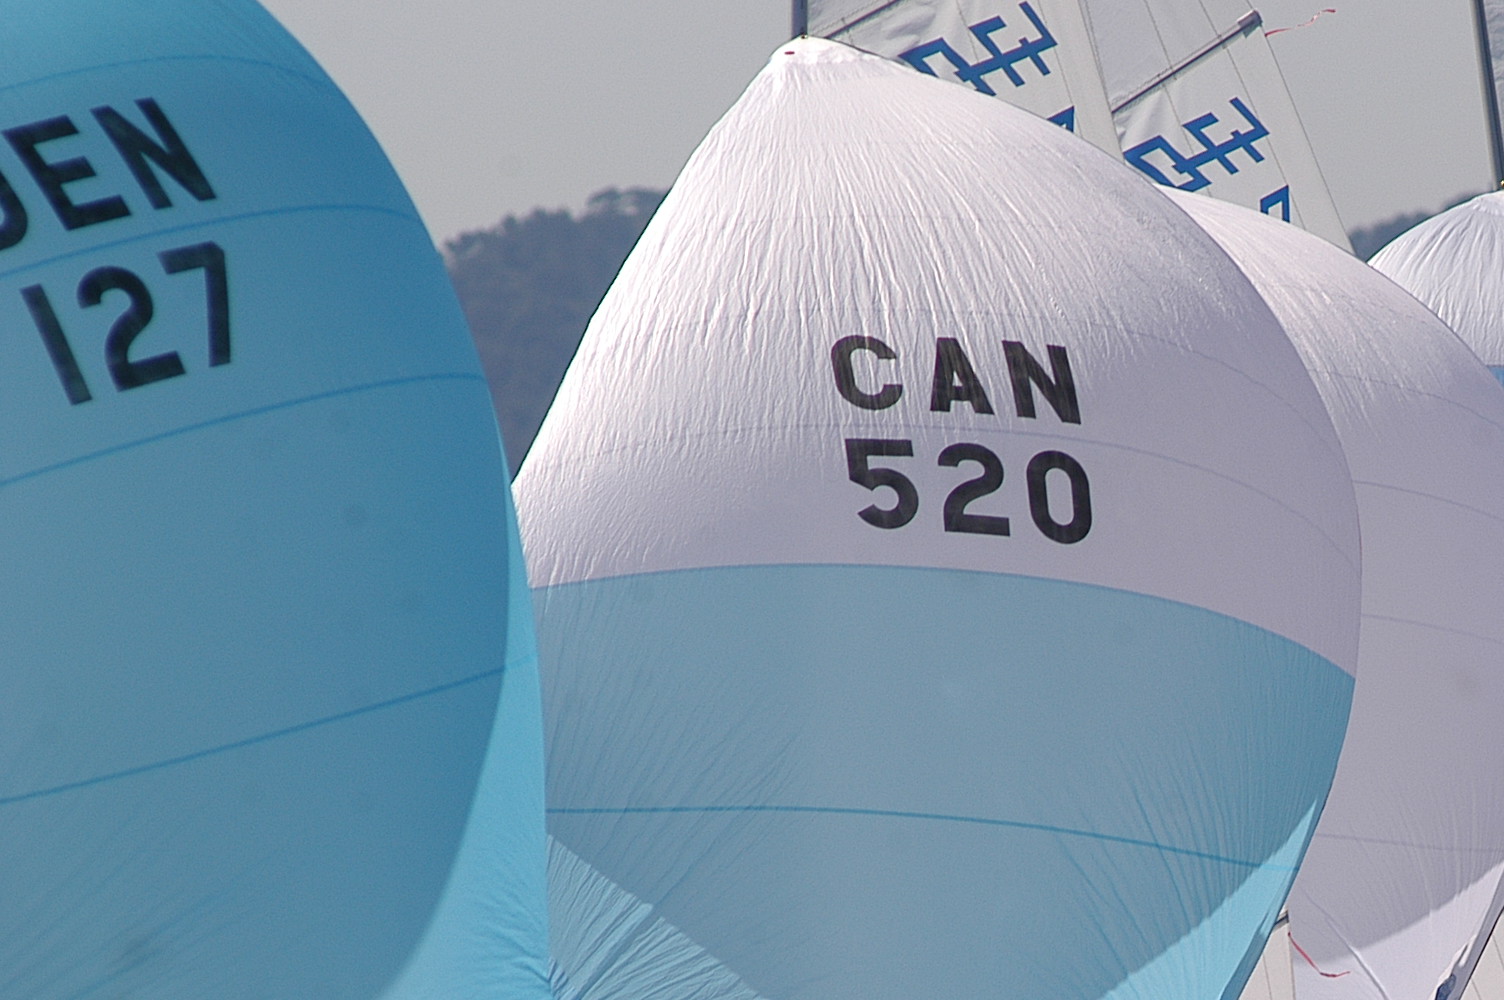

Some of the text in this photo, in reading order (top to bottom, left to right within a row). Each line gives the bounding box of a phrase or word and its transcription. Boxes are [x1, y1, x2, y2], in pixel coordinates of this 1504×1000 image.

[19, 240, 232, 406] 127
[830, 334, 1082, 425] CAN
[844, 437, 1093, 545] 520
